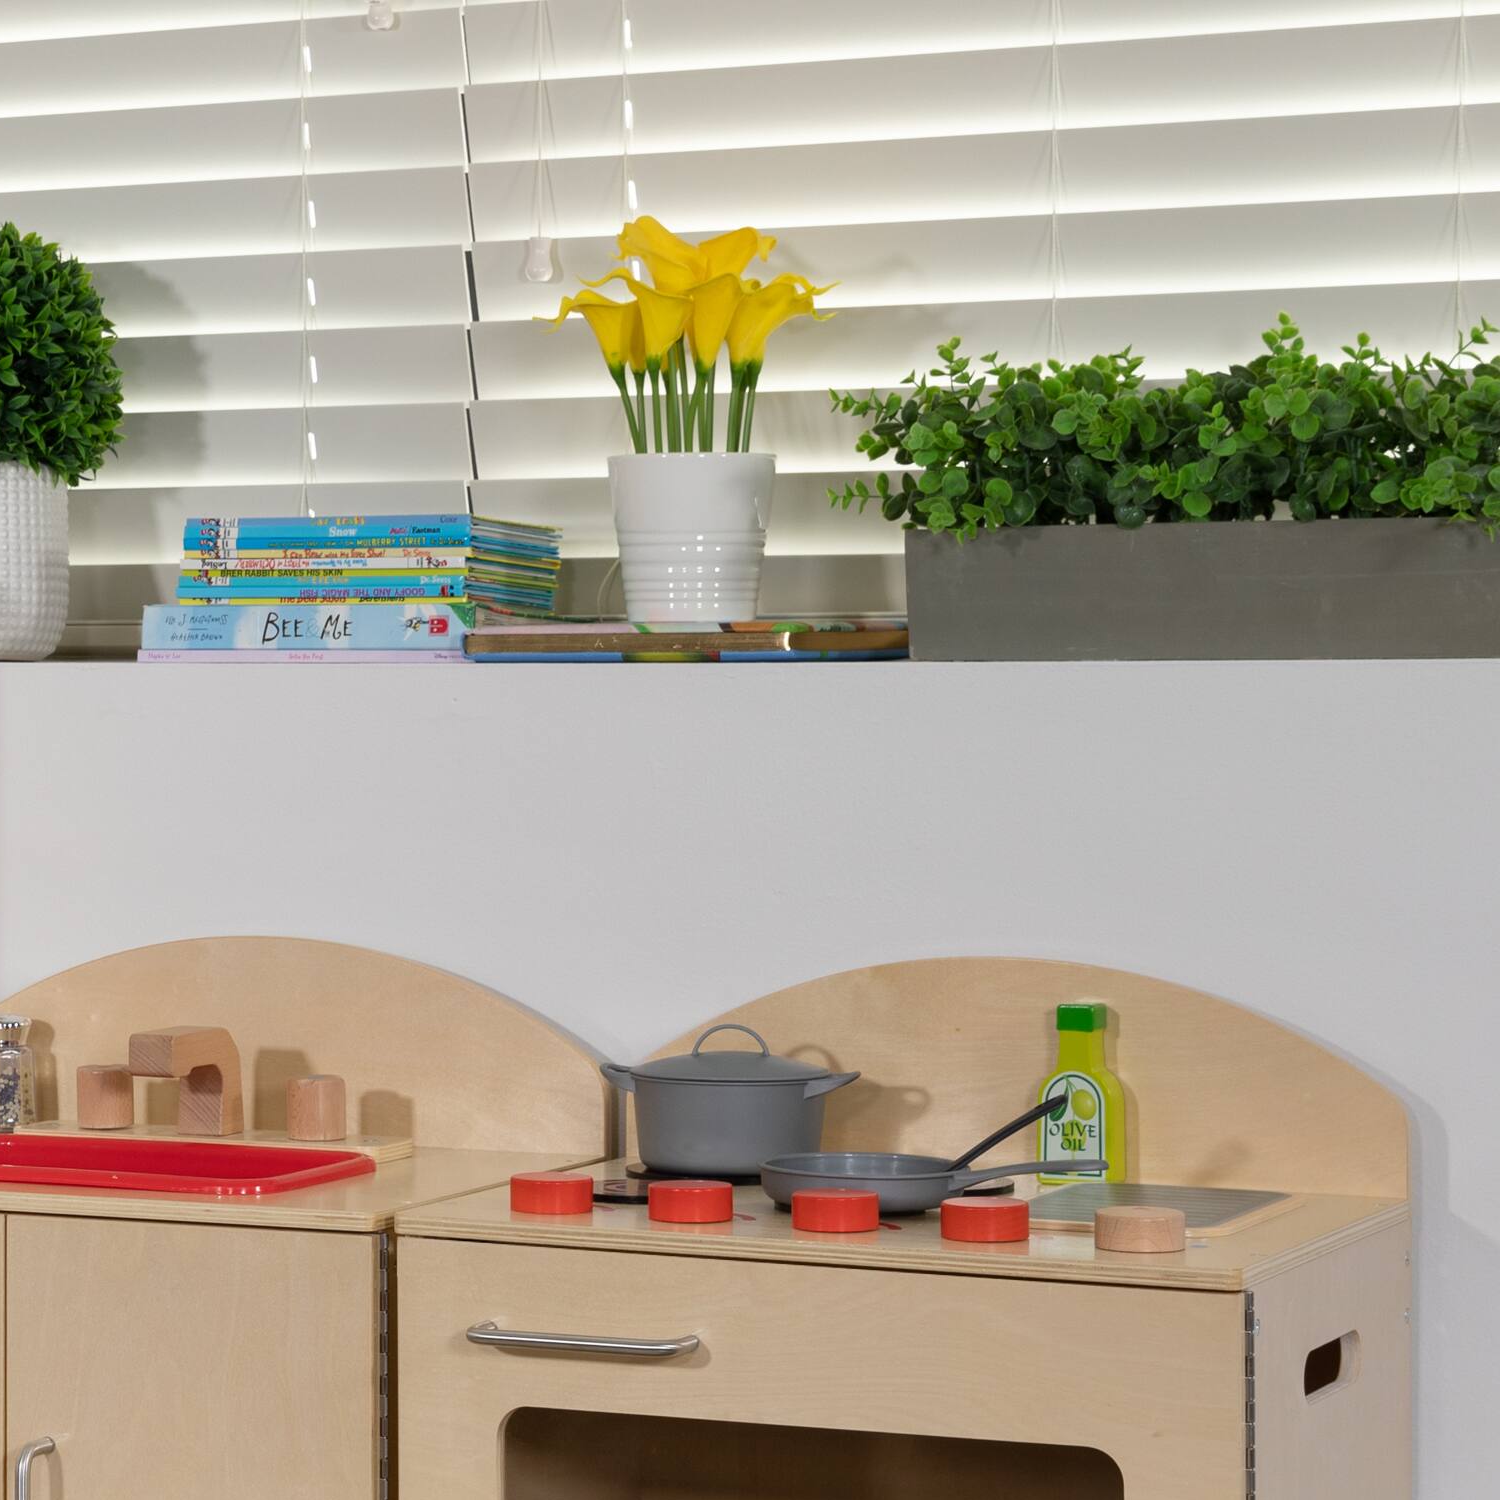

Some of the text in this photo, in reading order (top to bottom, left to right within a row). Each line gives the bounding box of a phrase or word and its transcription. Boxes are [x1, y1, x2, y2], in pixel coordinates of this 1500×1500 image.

[329, 526, 358, 537] Snow
[356, 537, 396, 546] MULBERRY
[399, 536, 426, 546] STREET
[220, 568, 343, 577] BRER RABBIT SAVES HIS SKIN
[299, 588, 425, 597] GOOFY AND THE MAGIC FISH
[262, 612, 304, 644] BEE
[320, 614, 353, 640] ME
[1049, 1122, 1097, 1138] OLIVE
[1061, 1137, 1086, 1152] OIL
